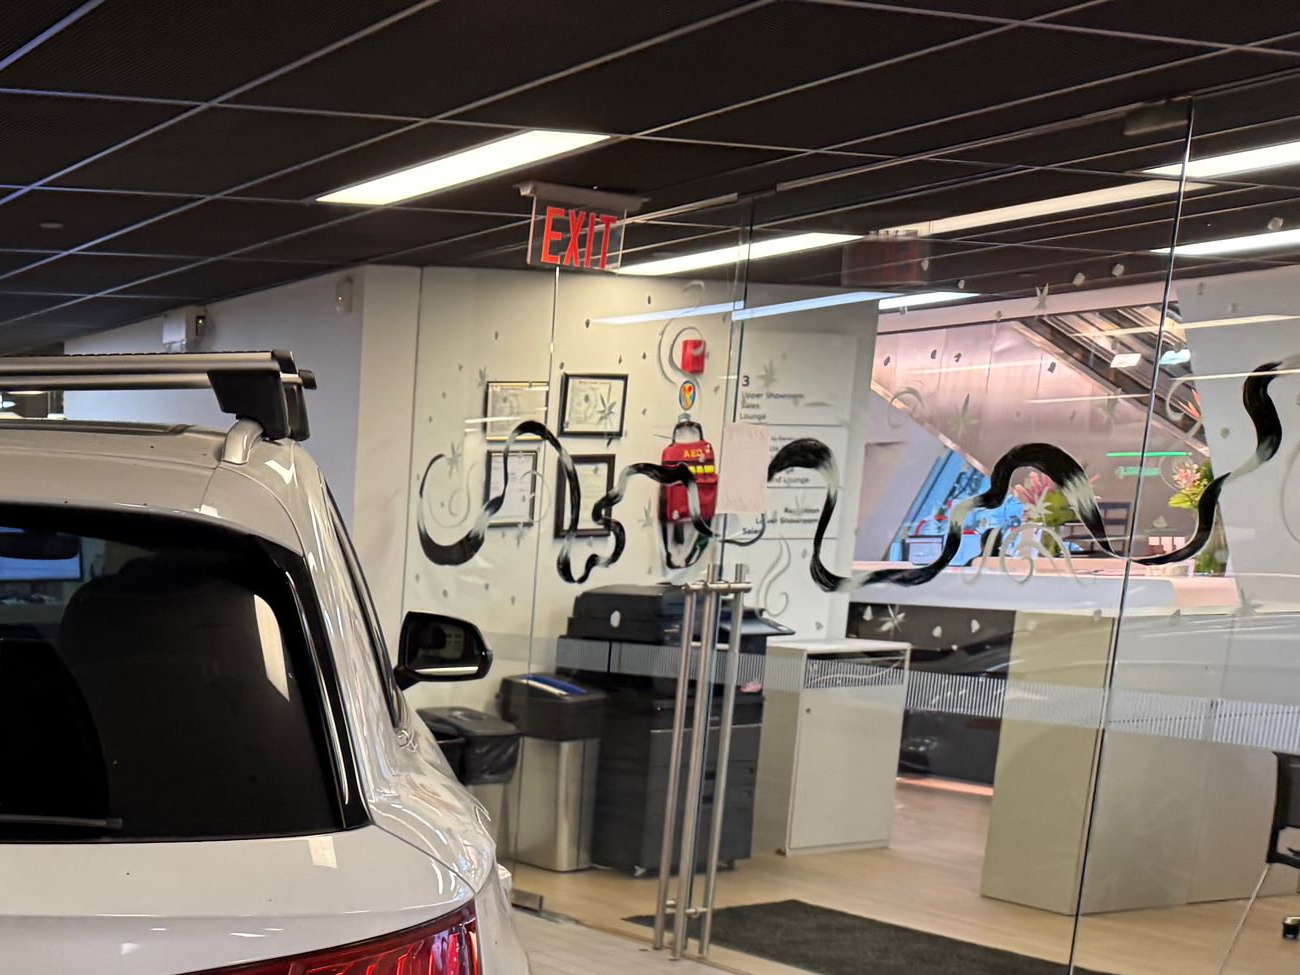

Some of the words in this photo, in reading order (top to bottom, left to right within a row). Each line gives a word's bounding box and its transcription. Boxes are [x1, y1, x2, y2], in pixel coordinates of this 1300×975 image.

[541, 206, 617, 270] EXIT
[741, 375, 750, 387] 3
[740, 413, 766, 421] Lounge
